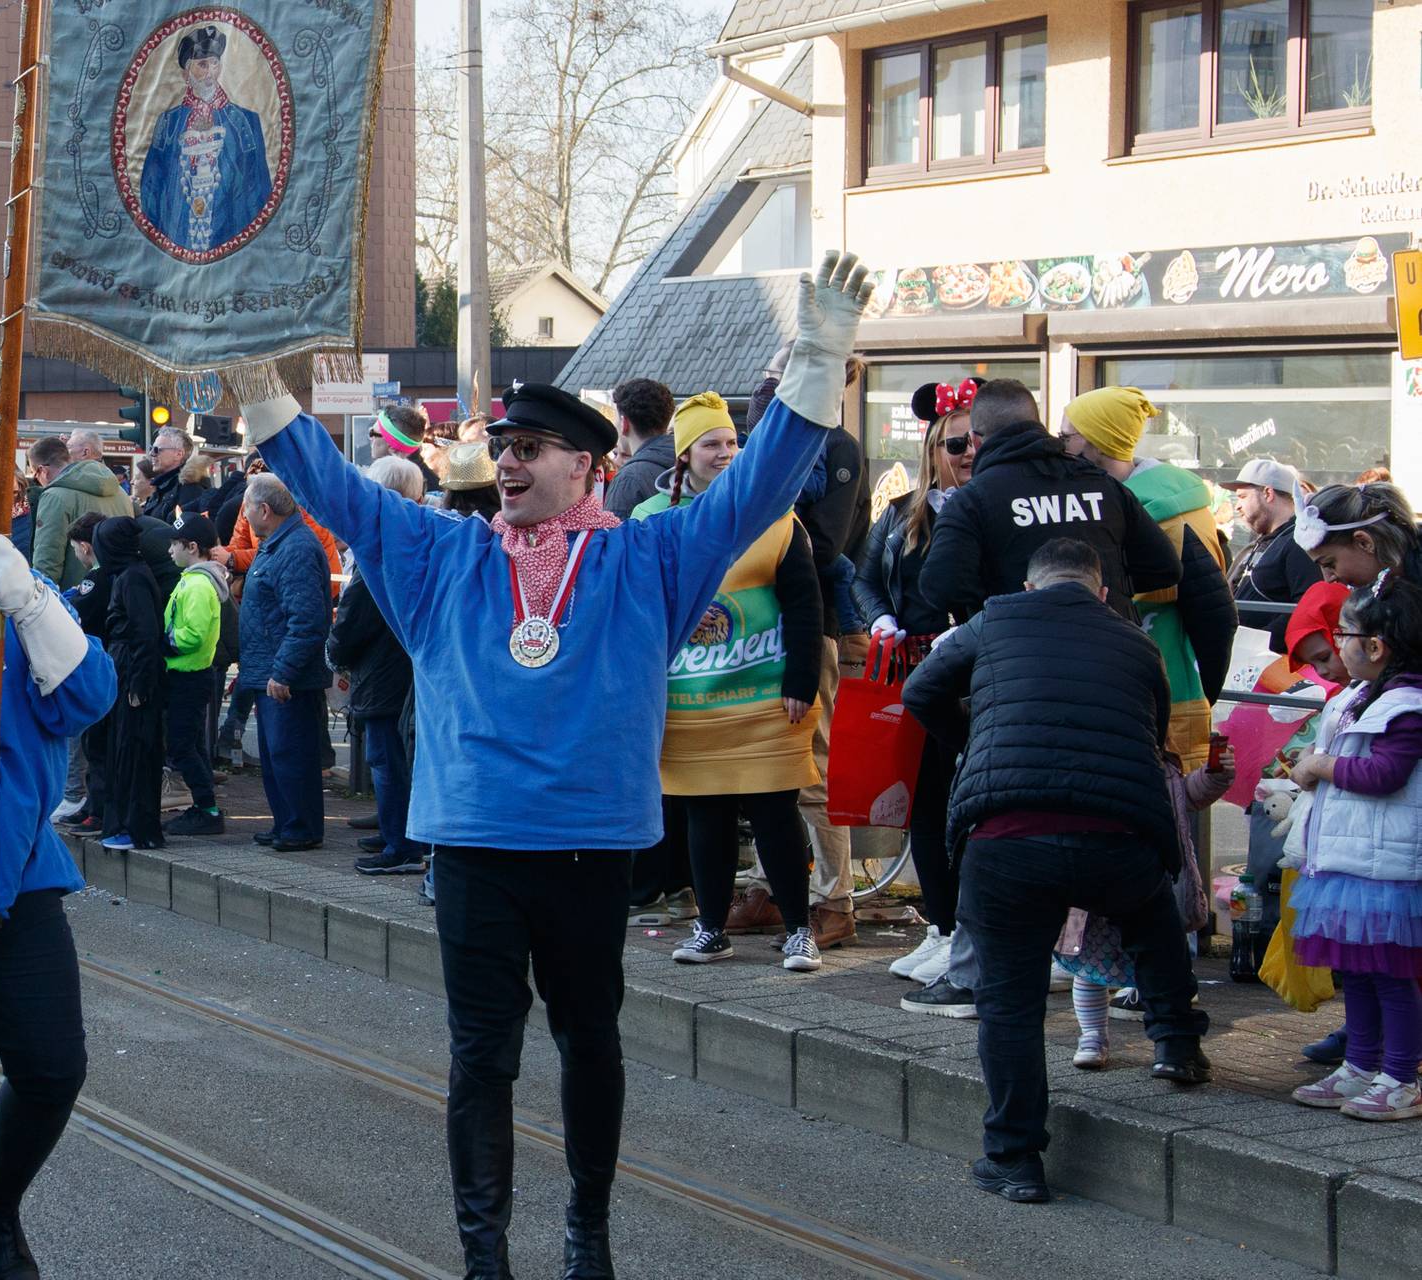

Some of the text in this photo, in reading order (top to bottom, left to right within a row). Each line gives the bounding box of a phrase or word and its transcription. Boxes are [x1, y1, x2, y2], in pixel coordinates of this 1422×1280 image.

[1307, 180, 1333, 202] Dr.
[1215, 246, 1330, 298] Mero
[1228, 418, 1276, 455] Neueröffnung
[1011, 492, 1104, 527] SWAT
